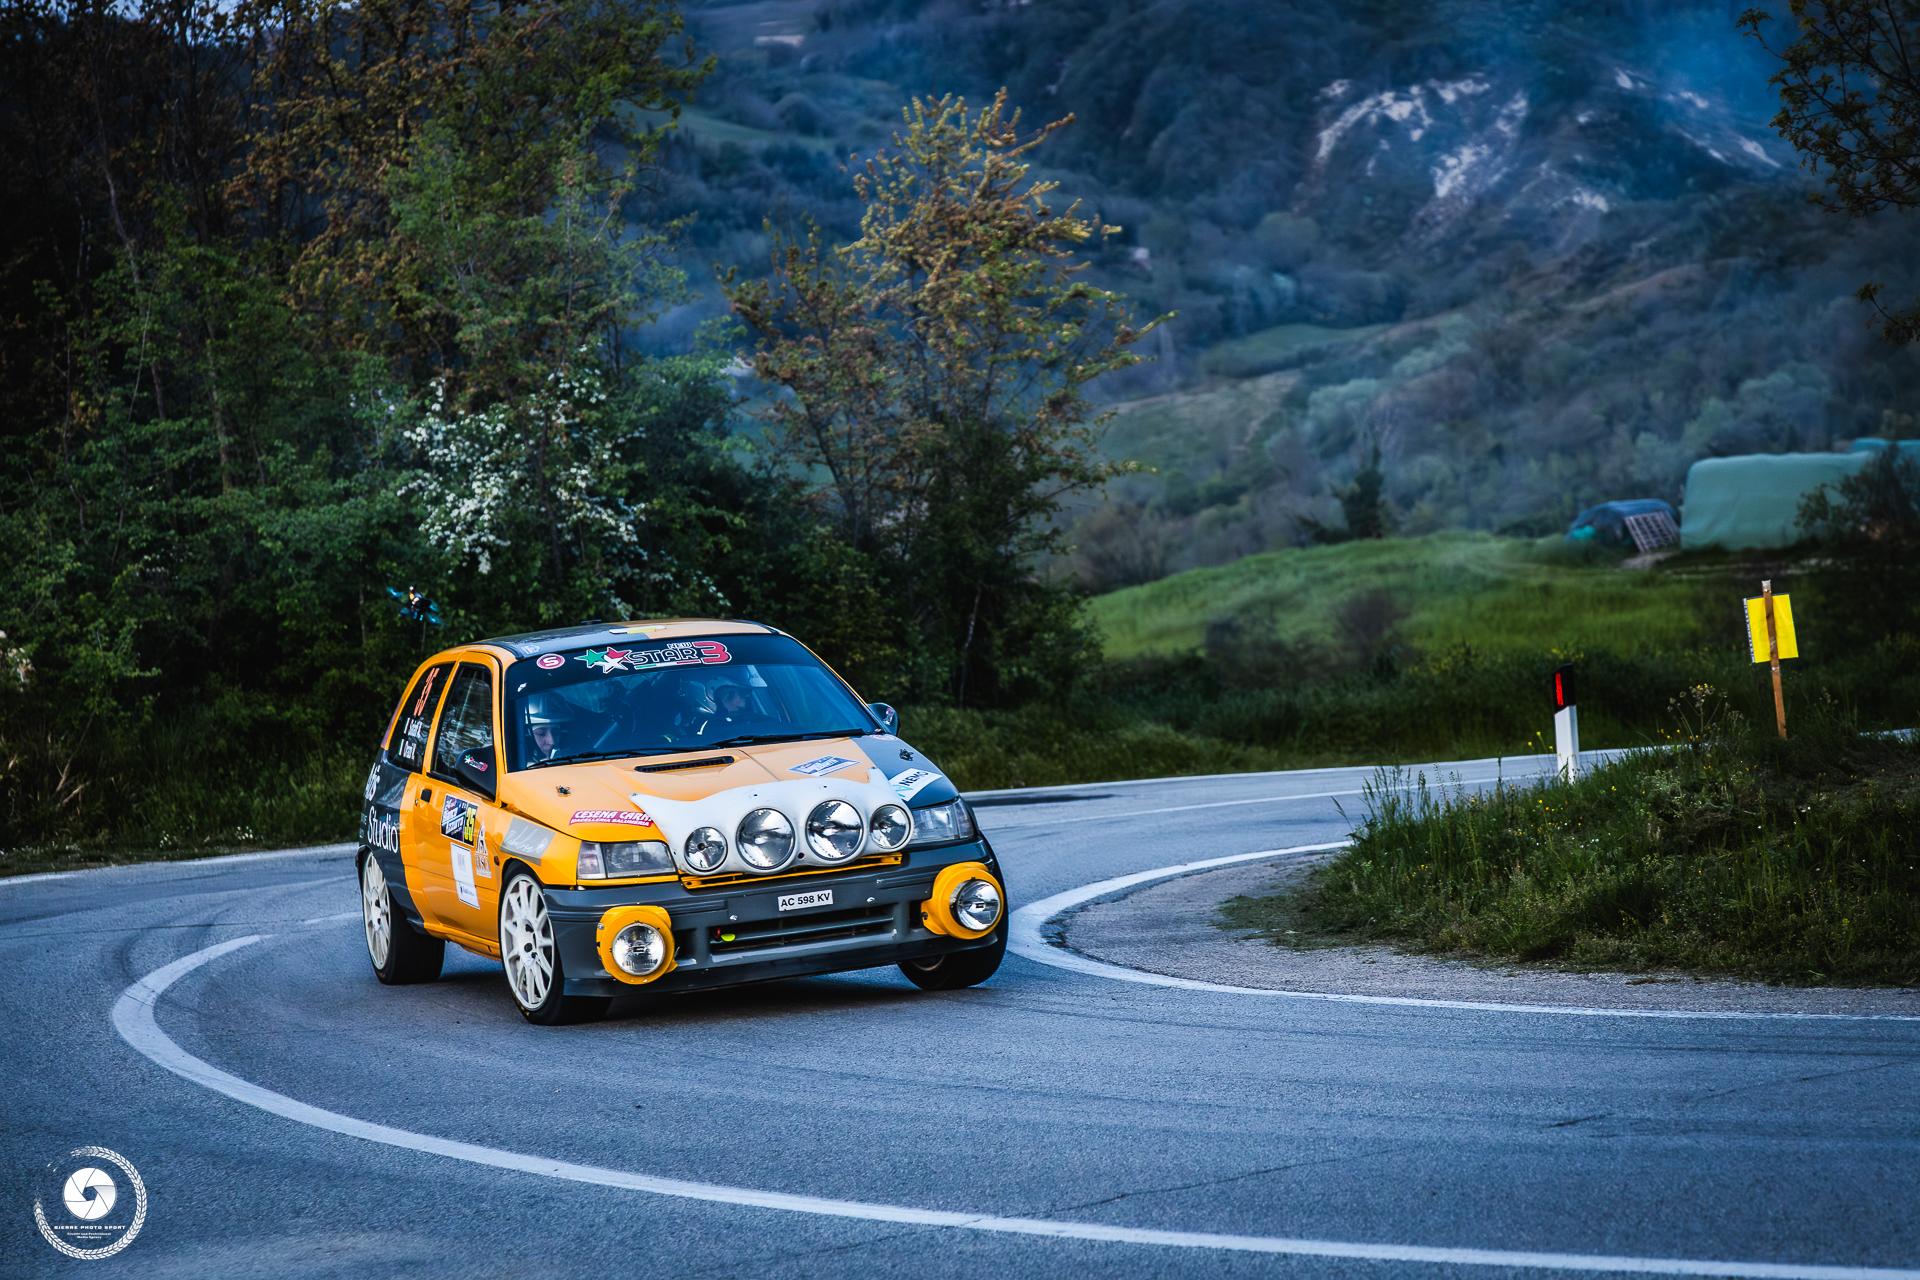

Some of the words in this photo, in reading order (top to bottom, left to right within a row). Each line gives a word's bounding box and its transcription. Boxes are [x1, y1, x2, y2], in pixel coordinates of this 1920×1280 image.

[543, 656, 559, 666] S
[627, 648, 698, 665] STAR
[692, 641, 732, 664] 3
[574, 810, 619, 818] CESENA
[367, 805, 398, 853] Studio
[464, 806, 477, 842] 35
[781, 898, 795, 907] AC
[797, 895, 815, 905] 598
[817, 892, 830, 902] KV
